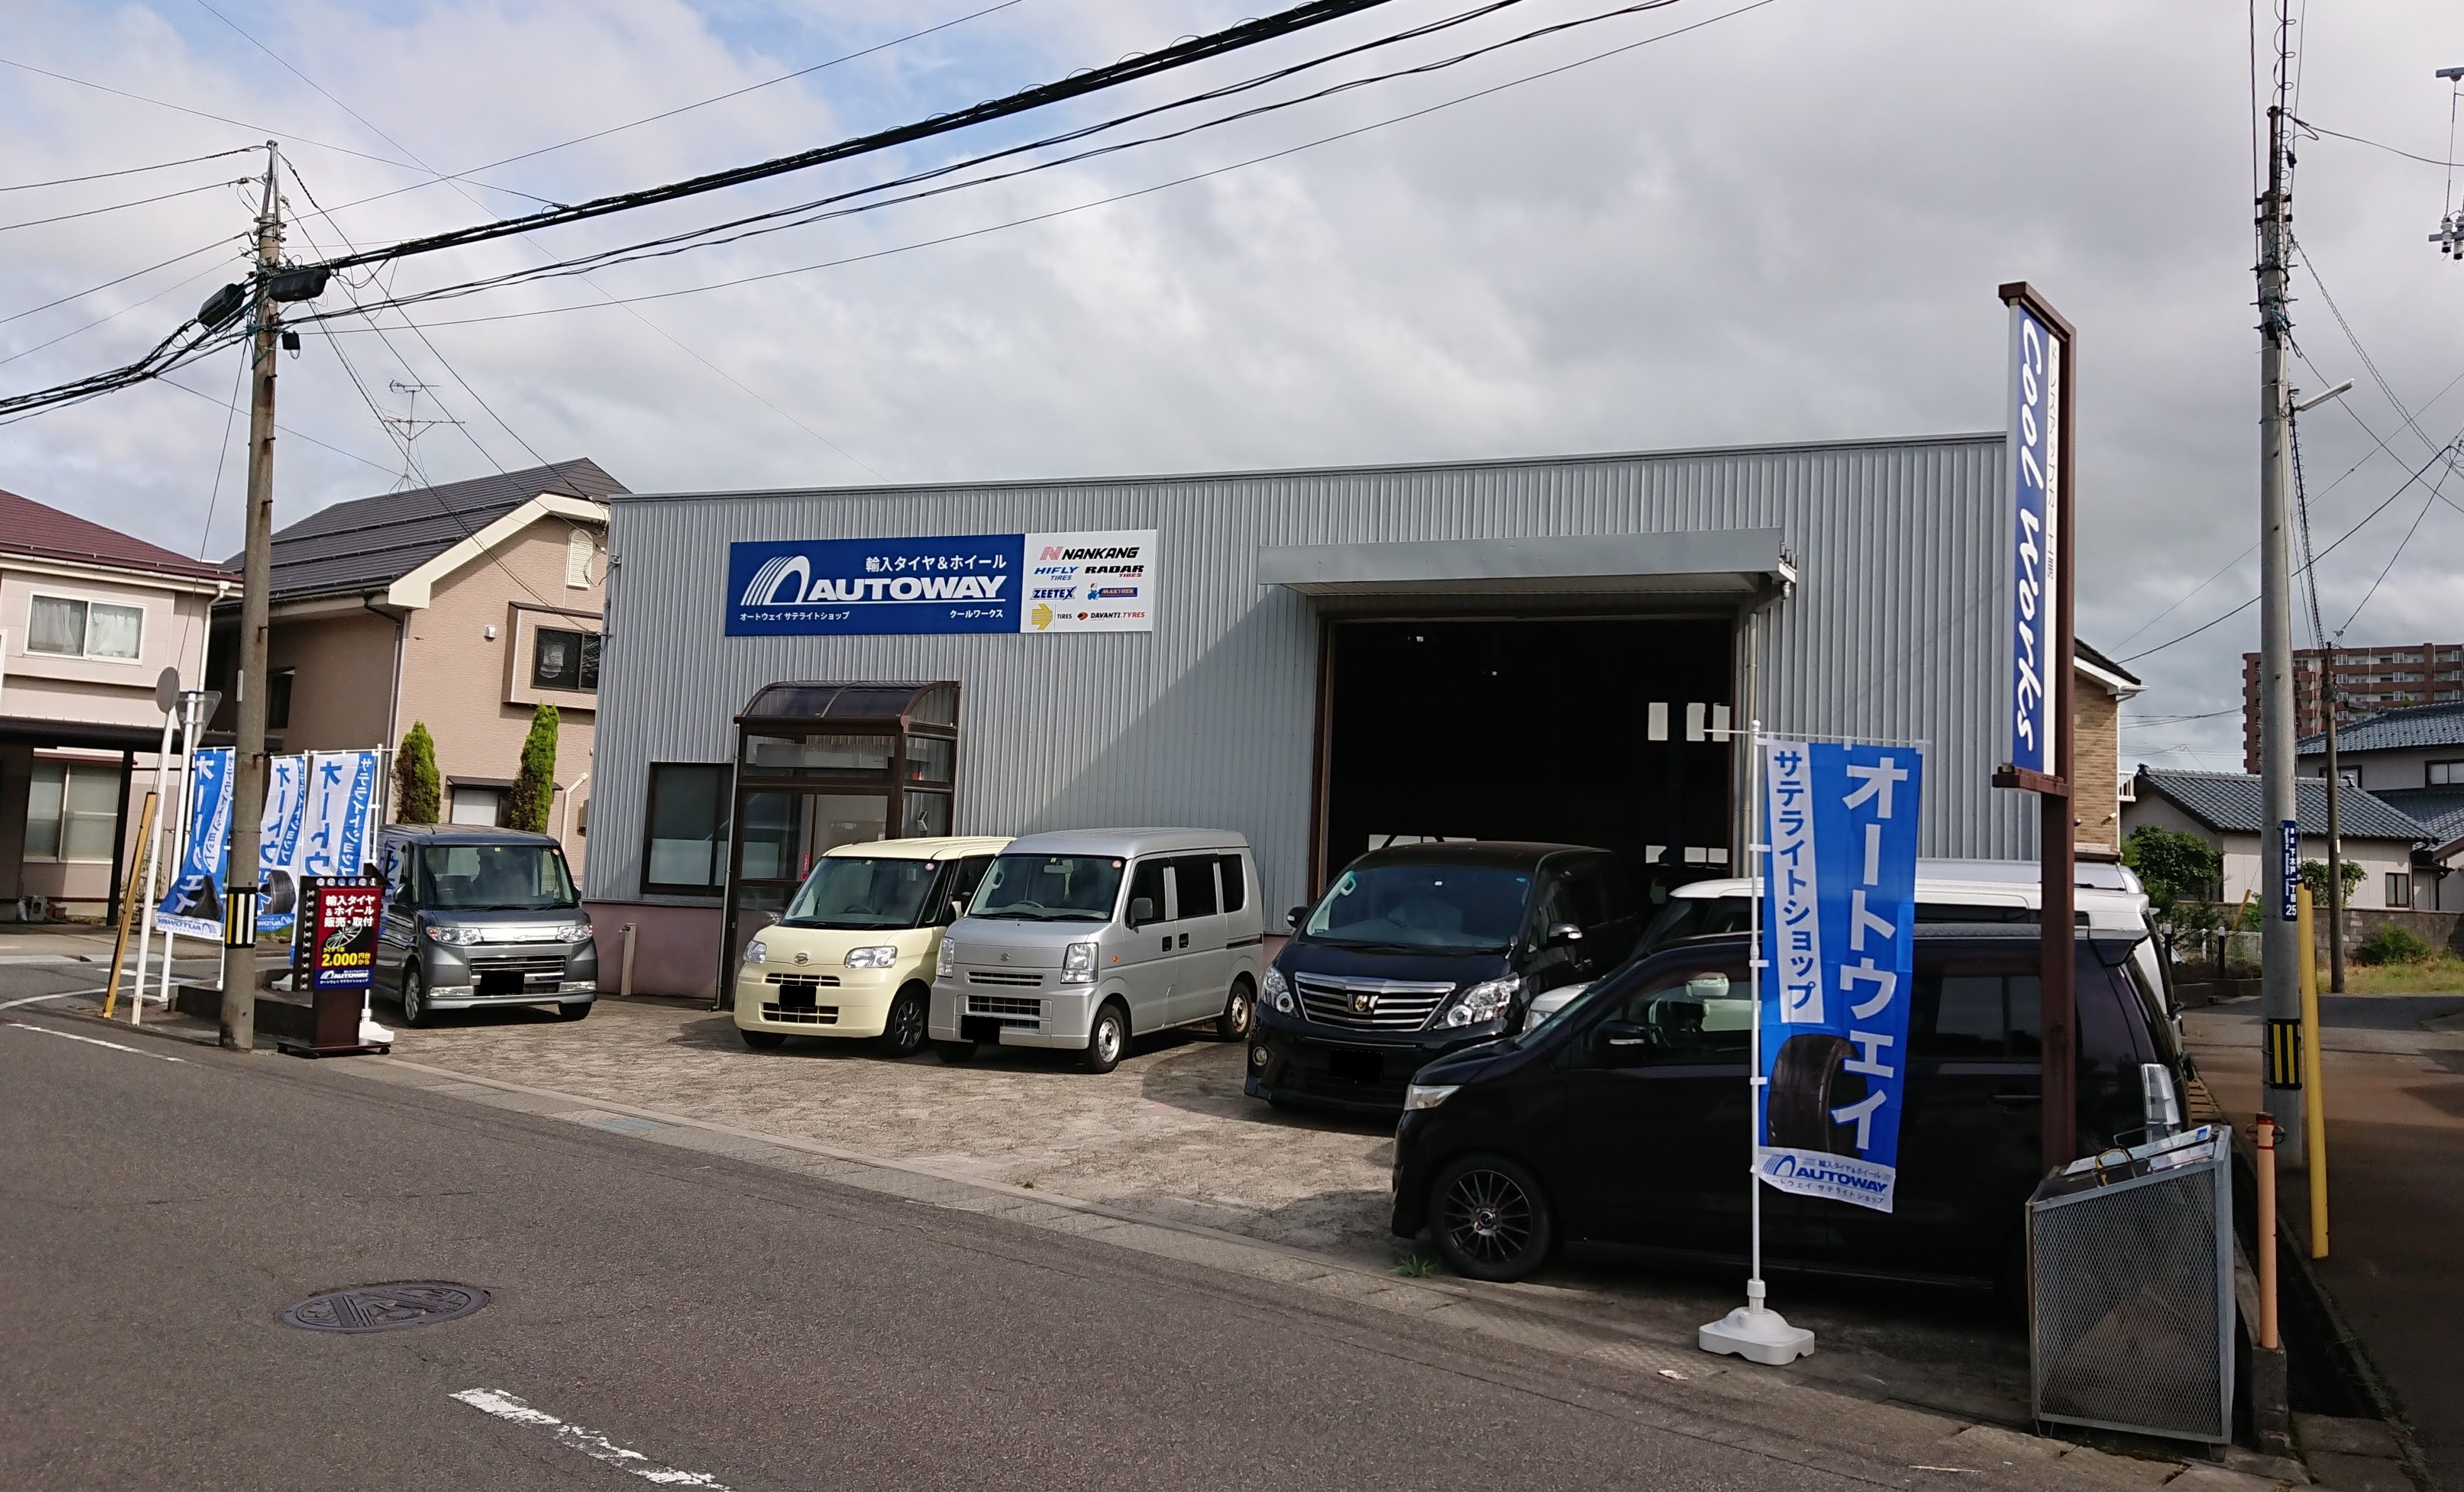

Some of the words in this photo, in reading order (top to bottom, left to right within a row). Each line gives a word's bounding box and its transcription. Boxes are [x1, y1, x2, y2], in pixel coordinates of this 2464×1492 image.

[1061, 547, 1140, 560] NANKANG
[866, 554, 1007, 572] 輸入タイヤ&ホイール
[1085, 565, 1144, 574] RADAR
[1034, 566, 1080, 575] HIFLY
[807, 575, 1007, 601] AUTOWAY
[1032, 585, 1077, 601] ZEETEX
[740, 613, 782, 621] オートウェイ
[784, 611, 850, 621] サテライトショップ
[950, 609, 1004, 618] クールワークス
[1773, 750, 1817, 1010] サテライトショップ
[326, 895, 376, 907] 輸入タイヤ
[2286, 905, 2297, 915] 25
[324, 917, 374, 927] 販売・取付
[322, 953, 357, 966] 2,000
[1831, 756, 1908, 1150] オートウェイ
[1796, 1167, 1888, 1193] AUTOWAY
